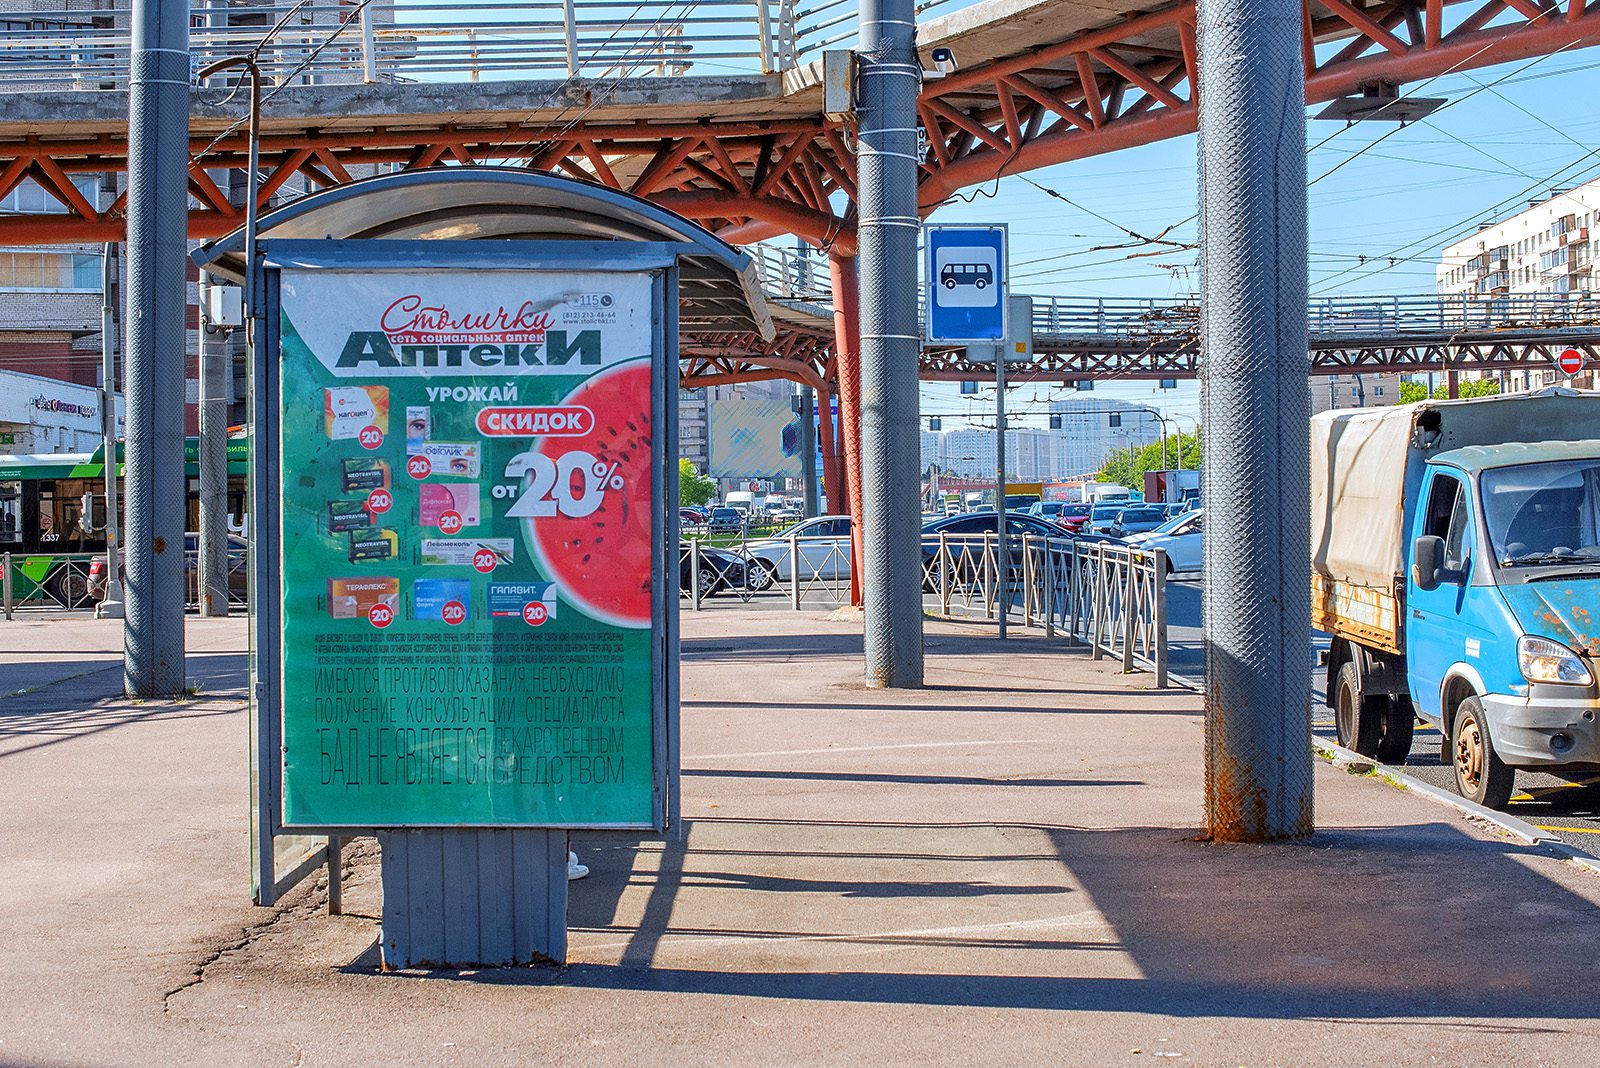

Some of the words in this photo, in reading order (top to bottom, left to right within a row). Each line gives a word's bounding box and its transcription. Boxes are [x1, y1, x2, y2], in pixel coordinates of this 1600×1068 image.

[381, 295, 556, 333] Столички
[391, 334, 418, 343] сеть
[420, 333, 503, 344] социальных
[505, 333, 544, 343] аптек
[426, 382, 518, 402] УРОЖАЙ
[487, 412, 583, 432] СКИДОК
[504, 450, 625, 518] 20%
[346, 583, 386, 591] ТЕРАФЛЕКС
[490, 585, 536, 595] ГАЛАВИТ
[314, 667, 380, 693] ИМЕЮТСЯ
[384, 666, 529, 694] ПРОТИВОПОКАЗАНИЯ.
[532, 666, 625, 695] НЕОБХОДИМО
[314, 697, 397, 723] ПОЛУЧЕНИЕ
[406, 696, 516, 726] КОНСУЛЬТАЦИИ
[525, 696, 625, 726] СПЕЦИАЛИСТА
[368, 727, 390, 785] НЕ
[395, 727, 488, 785] ЯВЛЯЕТСЯ
[493, 727, 624, 754] ЛЕКАРСТВЕННЫМ
[492, 755, 625, 787] СРЕДСТВОМ
